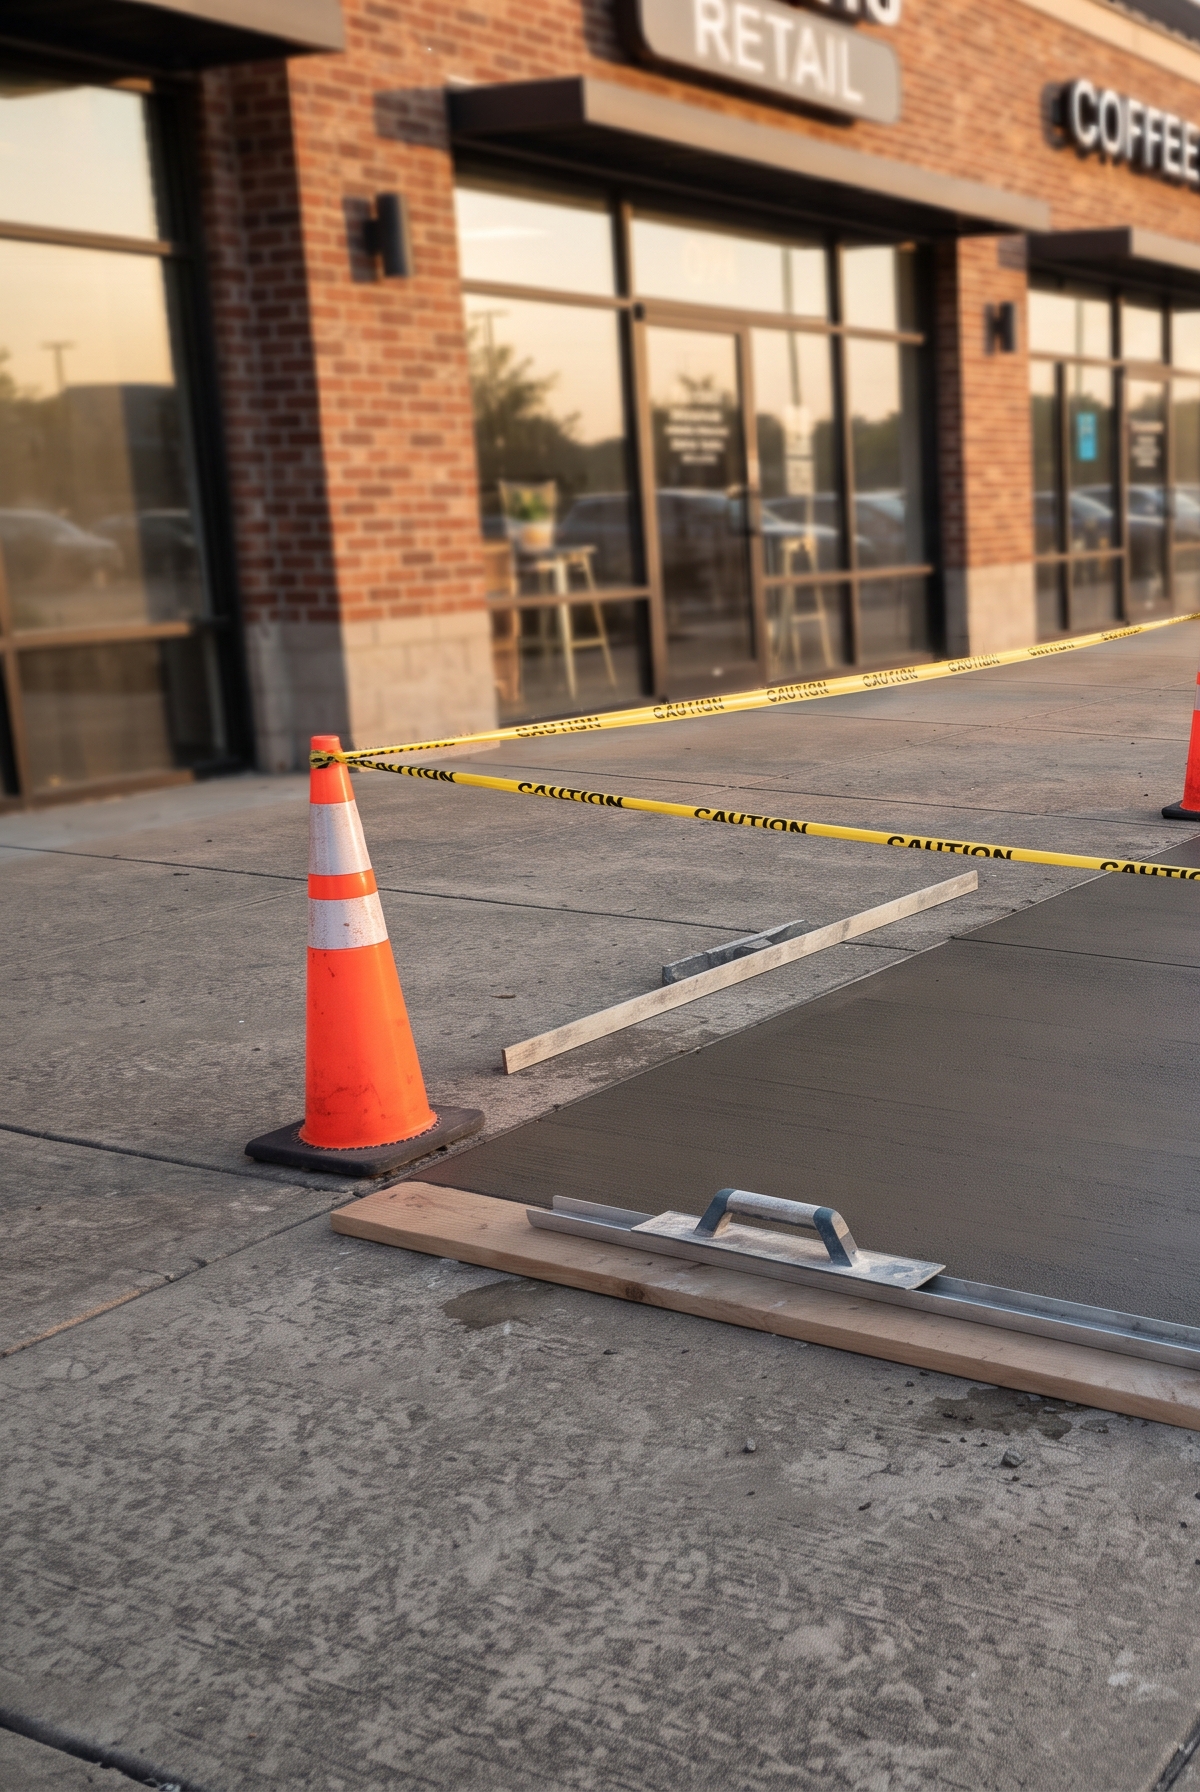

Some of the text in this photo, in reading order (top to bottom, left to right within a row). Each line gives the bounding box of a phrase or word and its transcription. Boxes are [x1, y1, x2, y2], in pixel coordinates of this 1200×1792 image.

[693, 0, 864, 103] RETAIL
[1073, 78, 1200, 182] COFFEE
[766, 681, 830, 703] CAUTION
[653, 697, 725, 719] CAUTION
[518, 782, 624, 808] CAUTION
[694, 807, 809, 835] CAUTION
[887, 836, 1013, 860] CAUTION
